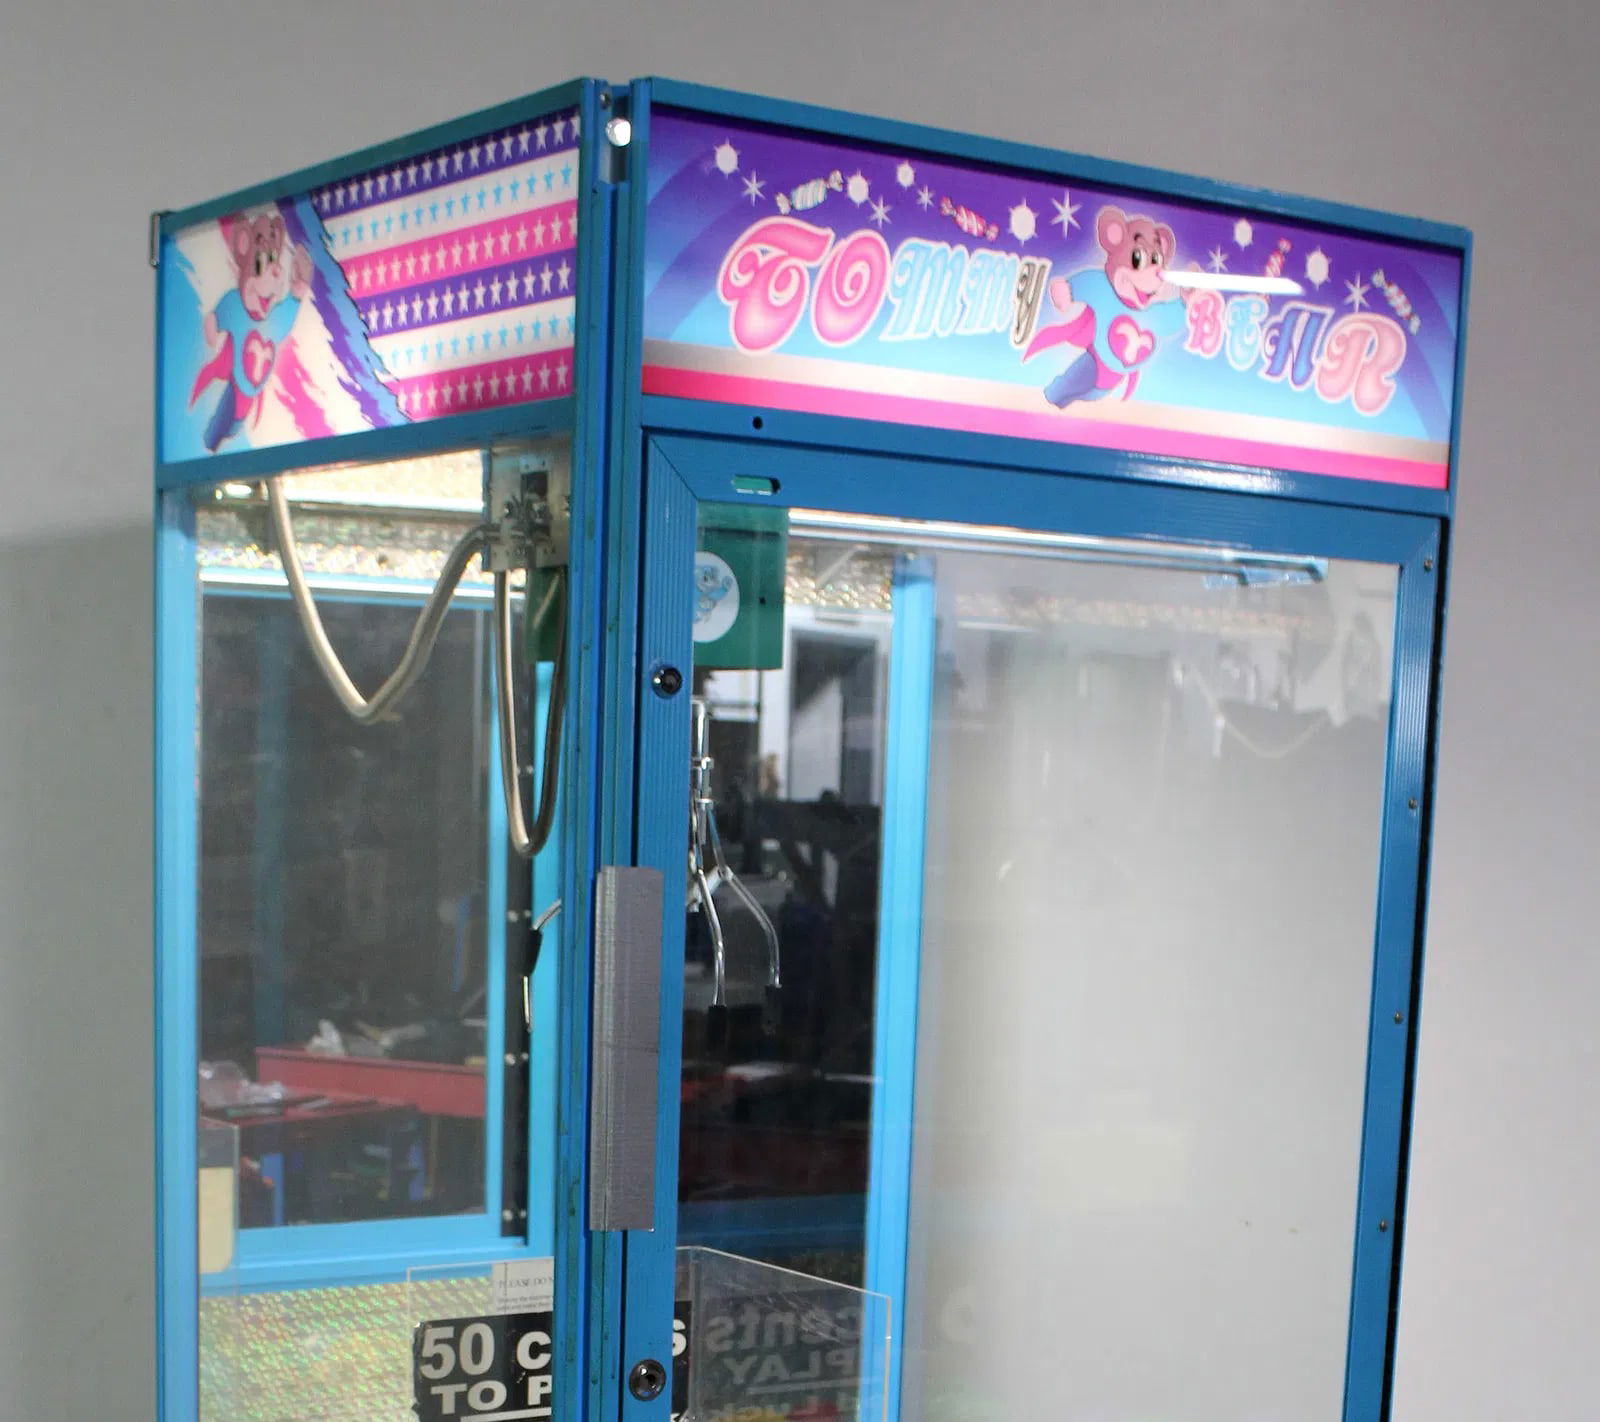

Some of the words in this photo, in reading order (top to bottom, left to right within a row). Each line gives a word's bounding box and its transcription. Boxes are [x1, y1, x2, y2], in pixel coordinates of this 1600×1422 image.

[1184, 289, 1407, 415] BEAR
[419, 1322, 495, 1380] 50
[430, 1380, 508, 1415] TO
